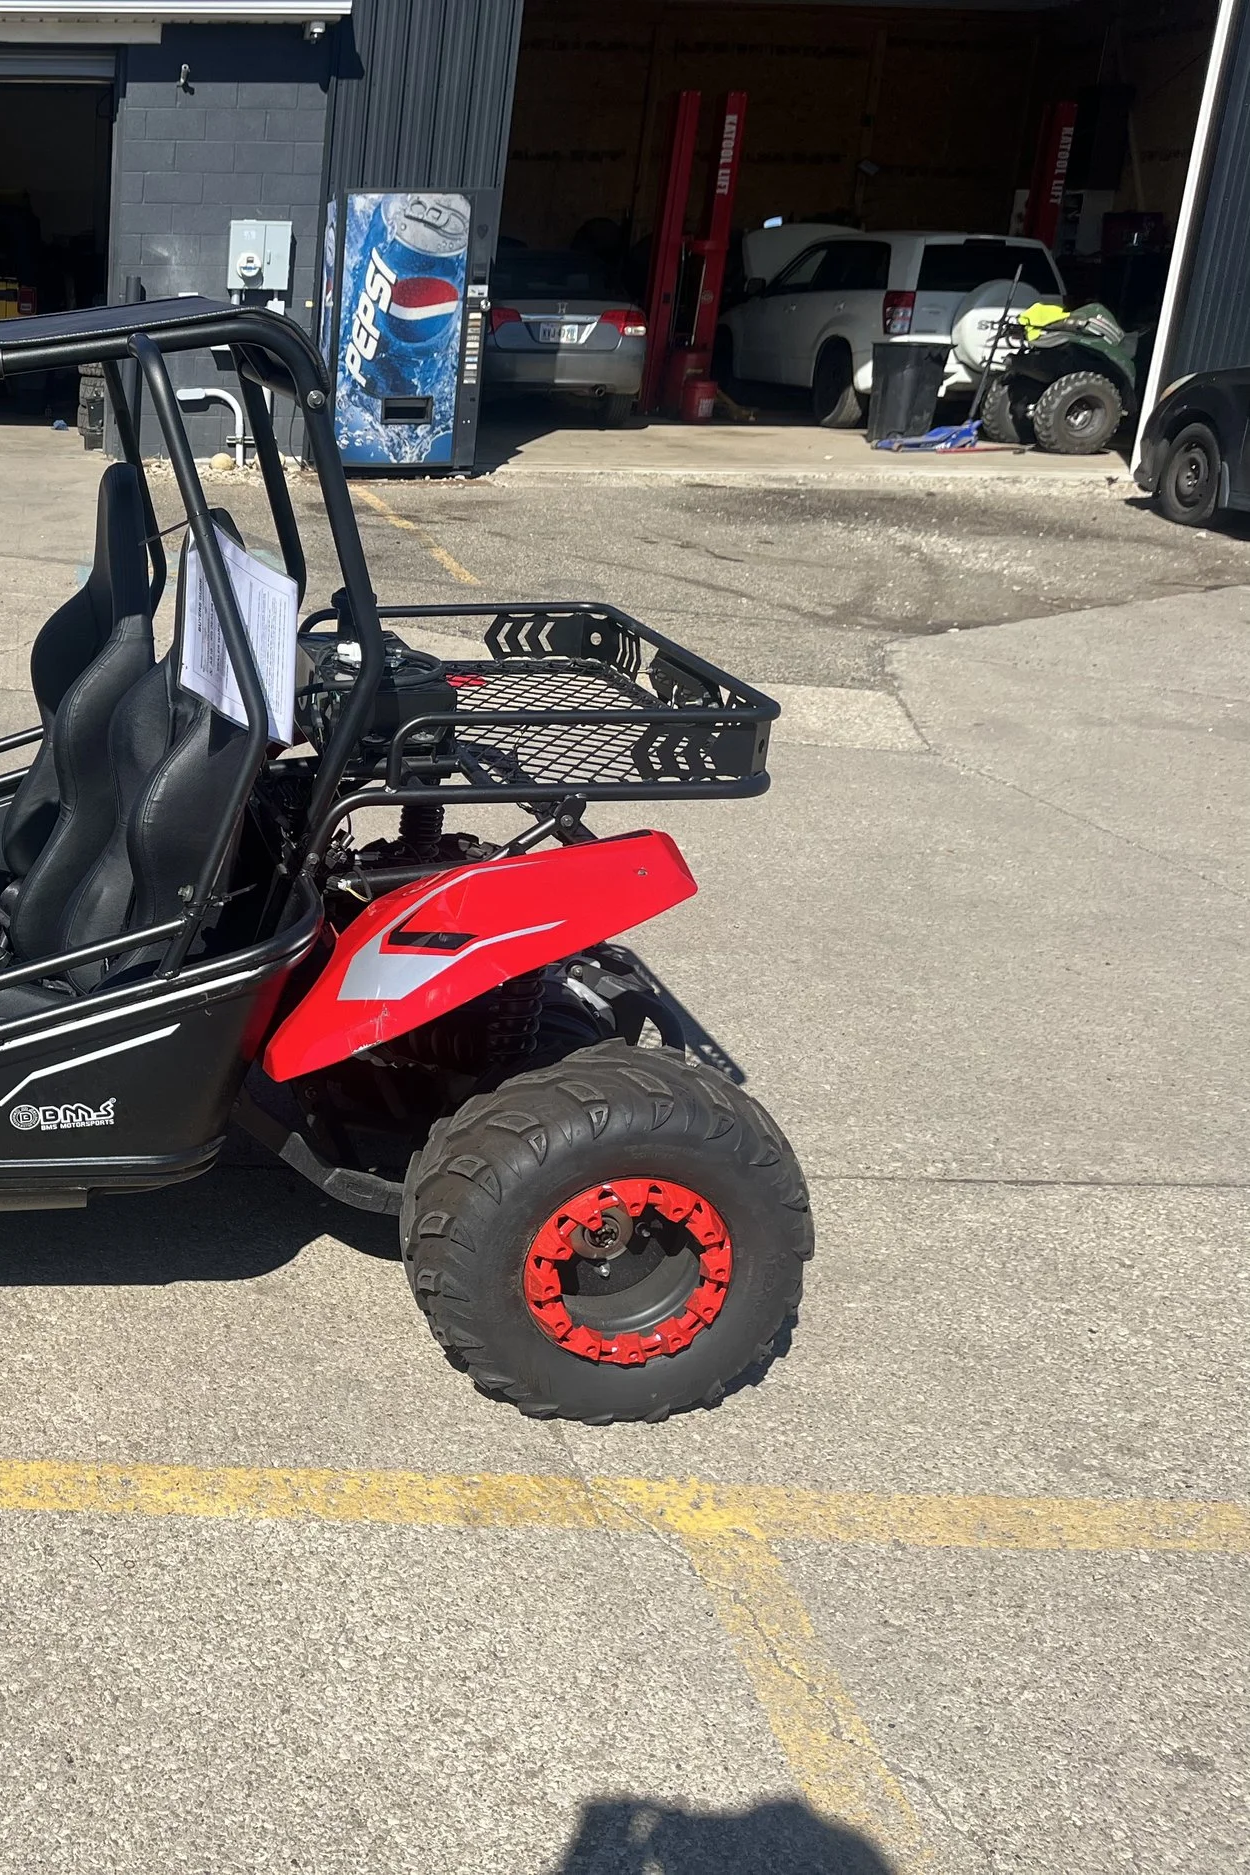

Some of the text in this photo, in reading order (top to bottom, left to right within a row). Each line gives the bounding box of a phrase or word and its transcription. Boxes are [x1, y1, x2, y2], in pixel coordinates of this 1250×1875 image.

[716, 114, 738, 195] KATOOL LIFT
[1049, 126, 1074, 205] KATOOL LIFT
[345, 247, 398, 387] PEPSI
[41, 1118, 115, 1131] BMS MOTORSPORTS
